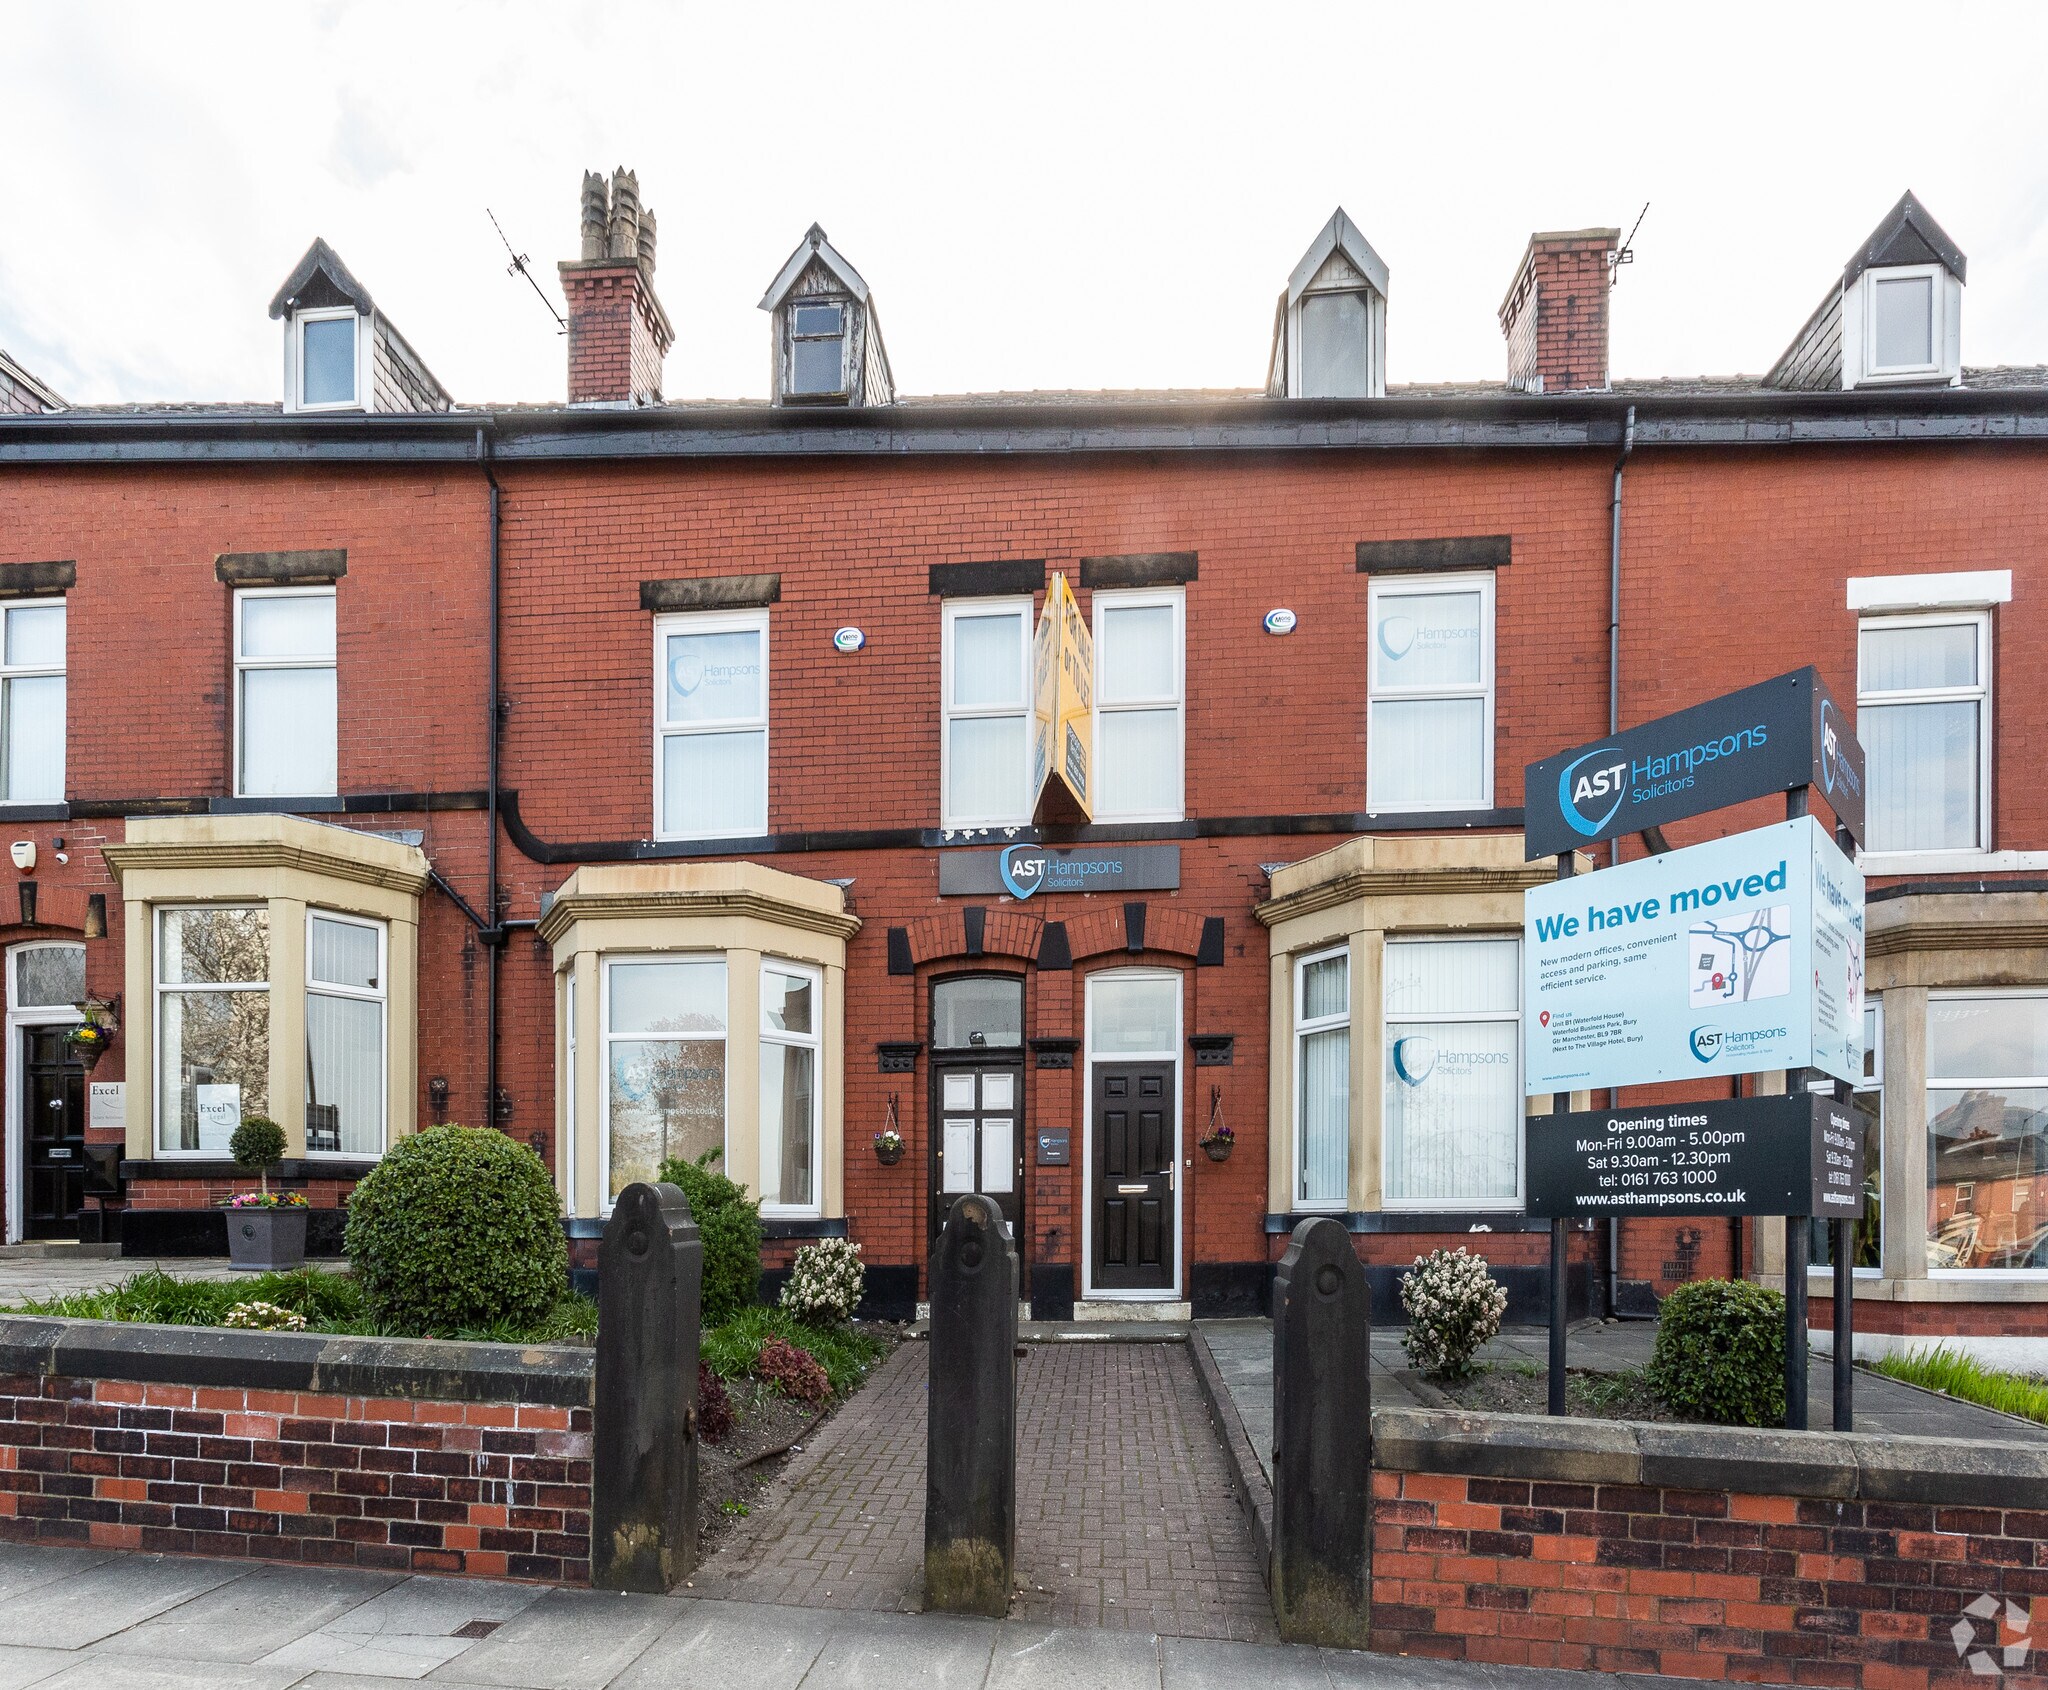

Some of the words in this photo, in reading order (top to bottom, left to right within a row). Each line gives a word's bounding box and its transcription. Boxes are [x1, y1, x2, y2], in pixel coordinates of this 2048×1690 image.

[1416, 627, 1479, 641] Hampsons
[704, 665, 760, 678] Hampsons
[1824, 722, 1837, 760] AST
[1572, 763, 1627, 804] AST
[1632, 724, 1767, 785] Hampsons
[1632, 775, 1695, 804] Solicitors
[1011, 859, 1045, 877] AST
[1047, 859, 1123, 878] Hampsons
[1815, 858, 1826, 896] We
[1047, 877, 1084, 887] Solicitors
[1535, 913, 1579, 943] We
[1588, 897, 1660, 932] have
[1670, 860, 1787, 914] moved
[1540, 957, 1558, 968] New
[1560, 950, 1592, 965] modern
[1593, 943, 1625, 958] offices,
[1627, 932, 1677, 950] convenient
[1540, 968, 1567, 980] access
[1569, 963, 1585, 976] and
[1587, 957, 1622, 974] parking,
[1623, 953, 1647, 964] same
[1540, 979, 1572, 992] efficient
[1574, 973, 1607, 985] service.
[1552, 1027, 1579, 1036] Waterfold
[1580, 1023, 1606, 1032] Business
[1623, 1018, 1637, 1026] Bury
[1573, 1015, 1602, 1026] (Waterfold
[1603, 1011, 1625, 1020] House)
[1587, 1039, 1607, 1049] Village
[1627, 1035, 1643, 1043] Bury)
[1697, 1033, 1722, 1047] AST
[1725, 1027, 1787, 1043] Hampsons
[1725, 1043, 1755, 1053] Solicitors
[1437, 1049, 1509, 1067] Hampsons
[1437, 1067, 1472, 1075] Solicitors
[92, 1086, 119, 1095] Excel
[200, 1103, 225, 1113] Excel
[1607, 1117, 1665, 1134] Opening
[1668, 1115, 1708, 1128] times
[1576, 1137, 1623, 1152] Mon-Fri
[1626, 1135, 1676, 1149] 9.00am
[1689, 1131, 1745, 1147] 5.00pm
[1588, 1157, 1608, 1169] Sat
[1611, 1154, 1659, 1168] 9.30am
[1671, 1151, 1731, 1167] 12.30pm
[1599, 1174, 1617, 1187] tel:
[1621, 1173, 1649, 1186] 0161
[1652, 1172, 1678, 1185] 763
[1682, 1170, 1717, 1184] 1000
[1576, 1189, 1746, 1206] www.asthampsons.co.uk
